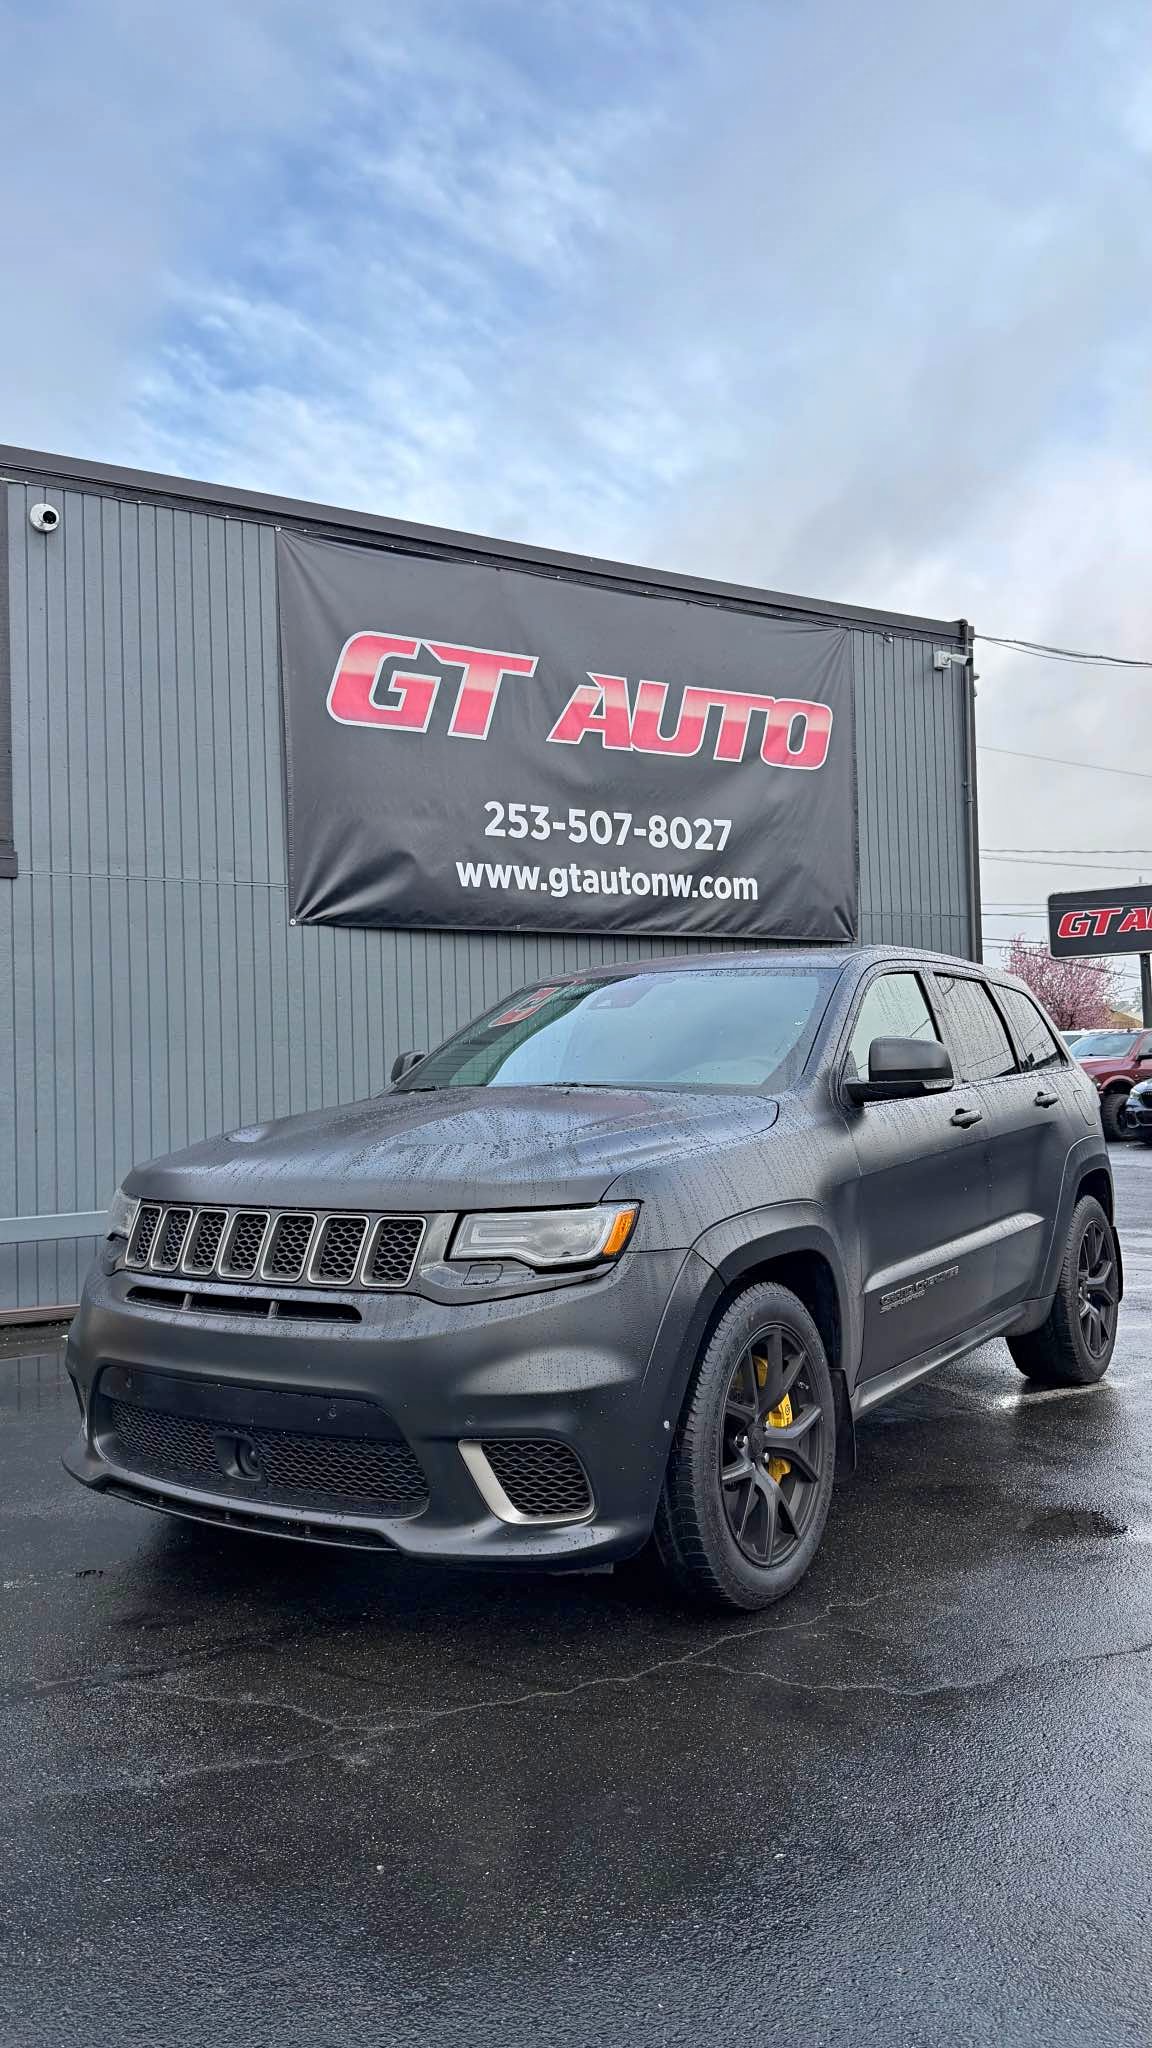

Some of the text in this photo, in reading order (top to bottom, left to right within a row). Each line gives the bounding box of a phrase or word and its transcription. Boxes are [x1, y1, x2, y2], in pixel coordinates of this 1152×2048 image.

[326, 631, 833, 770] GT AUTO
[484, 801, 733, 851] 253-507-8027
[455, 861, 759, 901] www.gtautonw.com
[1057, 907, 1152, 938] GT A
